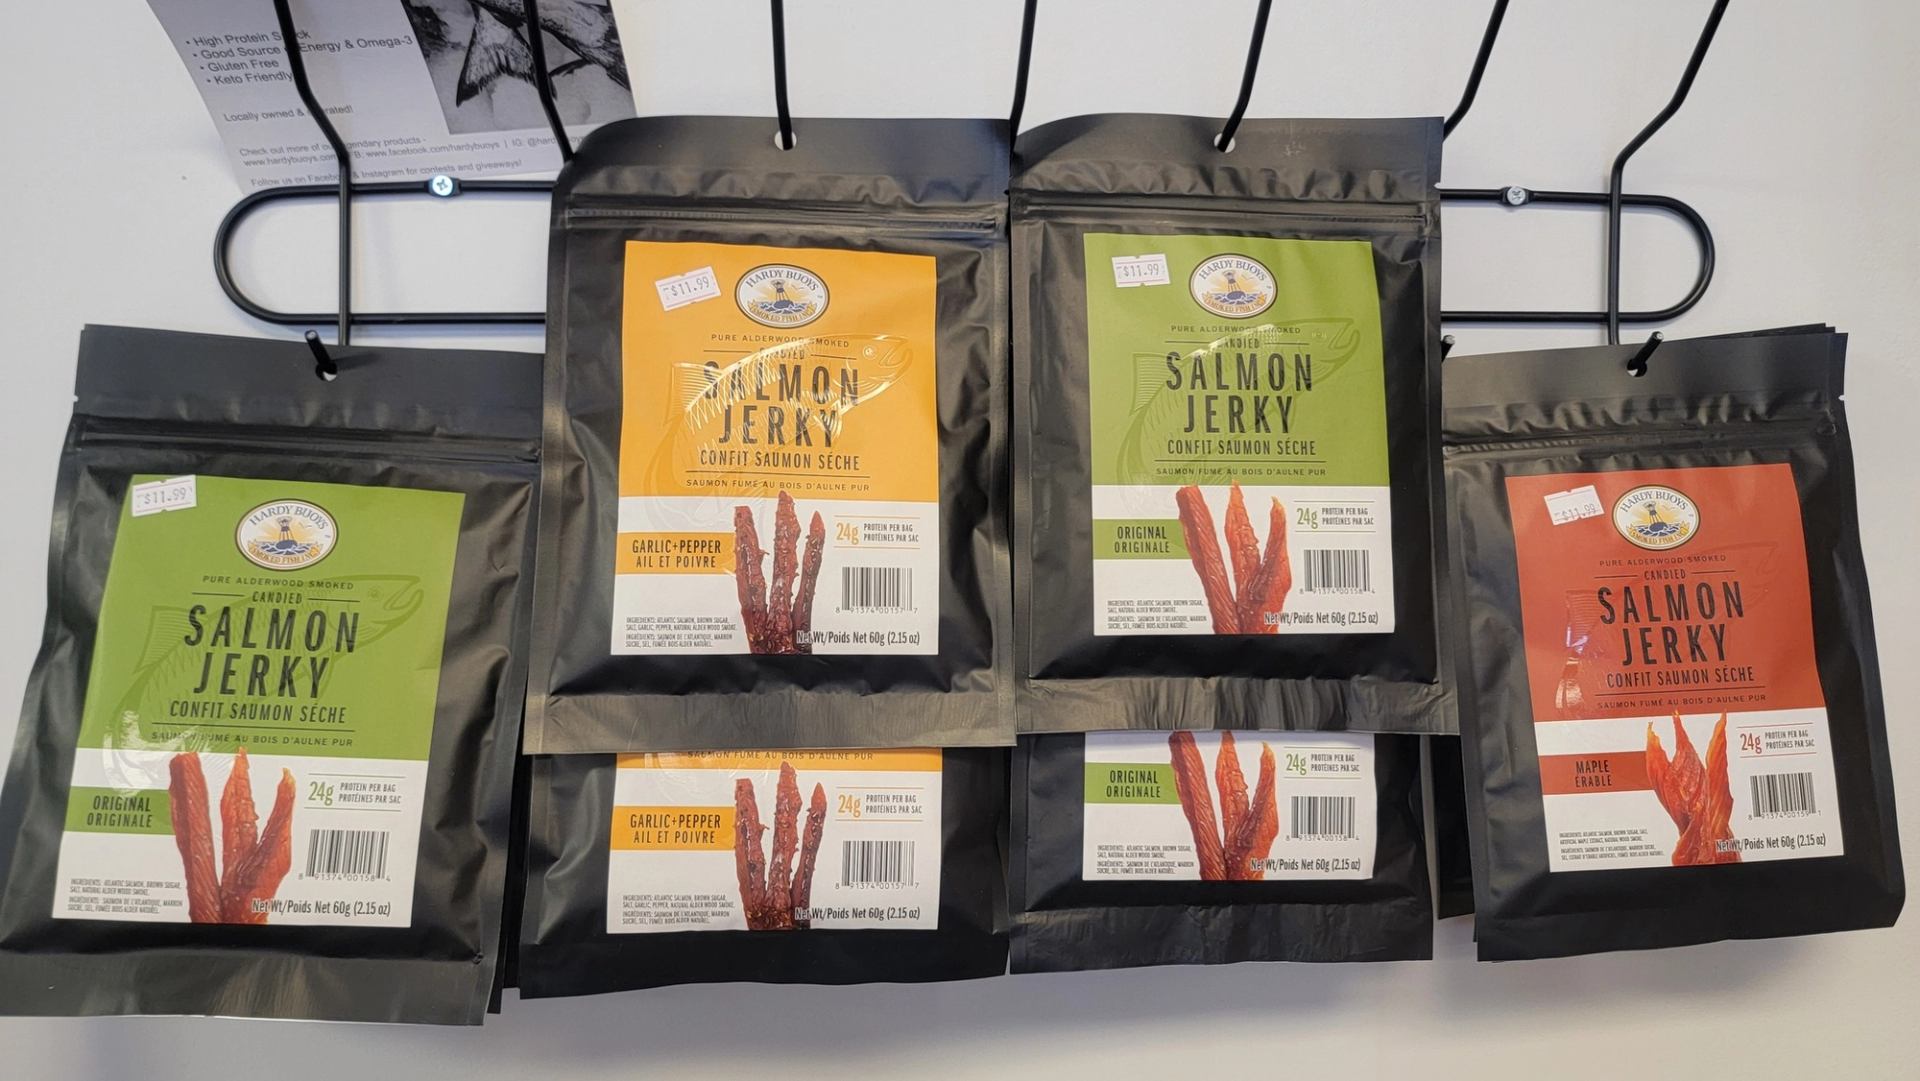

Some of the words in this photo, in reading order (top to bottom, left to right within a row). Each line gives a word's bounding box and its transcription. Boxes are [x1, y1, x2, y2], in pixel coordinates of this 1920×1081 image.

[194, 37, 222, 48] High
[226, 33, 269, 44] Protein
[201, 50, 239, 59] Good
[239, 46, 281, 57] Source
[300, 40, 341, 54] Energy
[357, 36, 413, 49] Omega-3
[208, 61, 248, 72] Gluten
[251, 59, 279, 69] Free
[214, 74, 243, 85] Keto
[247, 71, 294, 83] Friendly
[224, 110, 259, 122] Locally
[262, 110, 294, 120] owned
[1123, 263, 1160, 278] $11.99
[1198, 260, 1233, 279] HARDY
[1235, 260, 1268, 282] BUOYS
[671, 277, 710, 297] $11.99
[745, 269, 784, 288] HARDY
[785, 269, 819, 292] BUOYS
[1170, 325, 1195, 333] PURE
[1166, 351, 1313, 391] SALMON
[1183, 395, 1293, 434] JERKY
[719, 405, 837, 447] JERKY
[1167, 440, 1212, 455] CONFIT
[1217, 440, 1270, 455] SAUMON
[700, 450, 748, 466] CONFIT
[755, 452, 811, 469] SAUMON
[1156, 468, 1195, 476] SAUMON
[1266, 468, 1304, 476] D'AULNE
[686, 479, 727, 488] SAUMON
[779, 481, 802, 489] BOIS
[806, 483, 846, 491] D'AULNE
[143, 488, 187, 506] $11.99
[1620, 490, 1654, 513] HARDY
[1655, 490, 1688, 511] BUOYS
[249, 504, 294, 527] HARDY
[294, 505, 329, 531] BUOYS
[1297, 508, 1318, 529] 24g
[836, 522, 859, 544] 24g
[863, 523, 888, 531] PROTEIN
[889, 524, 901, 532] PER
[902, 524, 913, 532] BAG
[1117, 526, 1166, 539] ORIGINAL
[896, 534, 906, 542] PAR
[908, 534, 919, 542] SAC
[632, 539, 721, 553] GARLIC+PEPPER
[1114, 541, 1170, 553] ORIGINALE
[635, 556, 654, 568] AIL
[659, 556, 672, 567] ET
[676, 556, 716, 568] POIVRE
[1599, 559, 1623, 567] PURE
[1627, 557, 1684, 566] ALDERWOOD
[1687, 554, 1726, 563] SMOKED
[202, 575, 231, 584] PURE
[235, 577, 304, 587] ALDERWOOD
[308, 580, 354, 590] SMOKED
[1644, 569, 1687, 581] CANDIED
[252, 591, 303, 604] CANDIED
[1597, 581, 1745, 625] SALMON
[1264, 613, 1279, 624] Net
[1279, 613, 1314, 625] Wt/Poids
[1315, 613, 1329, 624] Net
[1331, 613, 1346, 626] 60g
[1348, 613, 1367, 625] (2.15
[1368, 613, 1378, 625] oz)
[184, 605, 360, 653] SALMON
[797, 631, 813, 644] Net
[813, 631, 851, 645] Wt/Poids
[853, 632, 868, 644] Net
[869, 632, 885, 646] 60g
[887, 632, 907, 645] (2.15
[909, 632, 920, 645] oz)
[1622, 624, 1727, 666] JERKY
[193, 652, 329, 699] JERKY
[1606, 671, 1651, 688] CONFIT
[1657, 669, 1709, 685] SAUMON
[1597, 700, 1636, 709] SAUMON
[1667, 698, 1680, 706] AU
[1683, 697, 1703, 705] BOIS
[1706, 695, 1745, 704] D'AULNE
[1748, 694, 1766, 702] PUR
[169, 700, 225, 719] CONFIT
[229, 702, 294, 722] SAUMON
[235, 733, 249, 743] AU
[252, 734, 278, 744] BOIS
[281, 736, 328, 747] D'AULNE
[332, 738, 353, 747] PUR
[1740, 733, 1762, 753] 24g
[1285, 754, 1306, 775] 24g
[1576, 760, 1609, 774] MAPLE
[1110, 770, 1158, 784] ORIGINAL
[308, 781, 333, 805] 24g
[1106, 786, 1161, 798] ORIGINALE
[92, 795, 151, 813] ORIGINAL
[838, 795, 861, 817] 24g
[86, 813, 153, 828] ORIGINALE
[630, 814, 721, 828] GARLIC+PEPPER
[633, 831, 652, 843] AIL
[657, 831, 670, 843] ET
[675, 831, 715, 843] POIVRE
[1716, 841, 1730, 852] Net
[1729, 839, 1764, 852] Wt/Poids
[1765, 838, 1779, 849] Net
[1781, 837, 1795, 851] 60g
[1797, 835, 1815, 848] (2.15
[1816, 835, 1826, 847] oz)
[1251, 859, 1265, 871] Net
[1265, 859, 1299, 872] Wt/Poids
[1300, 859, 1314, 871] Net
[1315, 859, 1330, 872] 60g
[1332, 859, 1350, 872] (2.15
[1351, 859, 1361, 872] oz)
[252, 901, 269, 914] Net
[270, 900, 312, 916] Wt/Poids
[314, 901, 331, 914] Net
[333, 901, 351, 917] 60g
[353, 902, 376, 916] (2.15
[377, 902, 391, 917] oz)
[795, 907, 810, 919] Net
[811, 907, 849, 921] Wt/Poids
[851, 908, 866, 919] Net
[868, 908, 884, 921] 60g
[887, 907, 907, 920] (2.15
[908, 908, 920, 920] oz)
